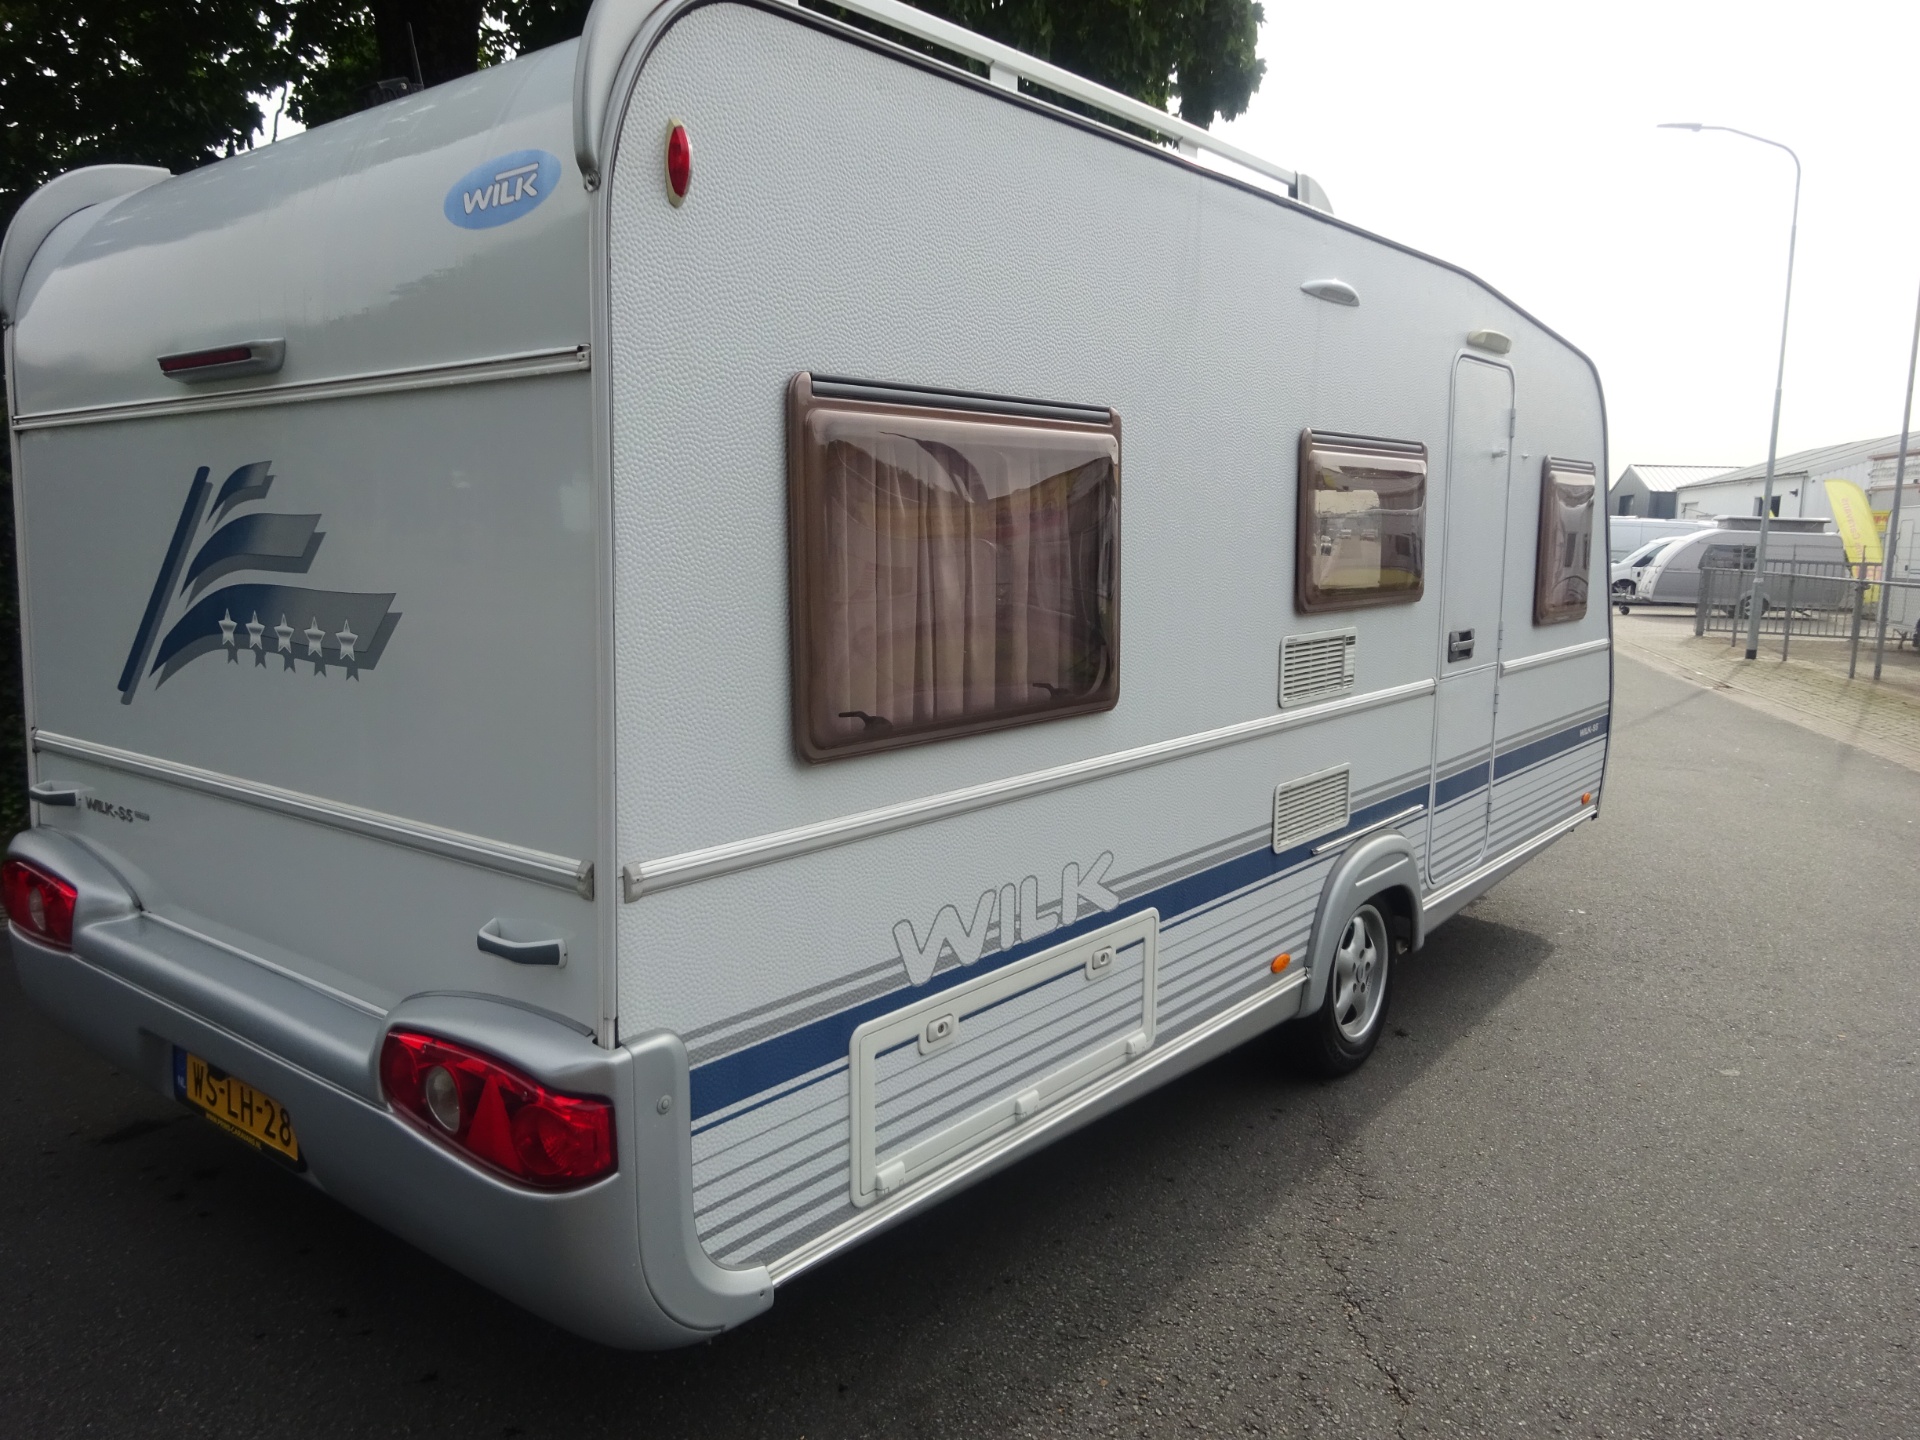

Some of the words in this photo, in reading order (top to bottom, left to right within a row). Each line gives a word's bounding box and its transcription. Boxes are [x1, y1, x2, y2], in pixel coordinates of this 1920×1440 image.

[463, 170, 539, 216] WILK
[892, 850, 1120, 987] WILK
[192, 1061, 292, 1147] WS-LH-28
